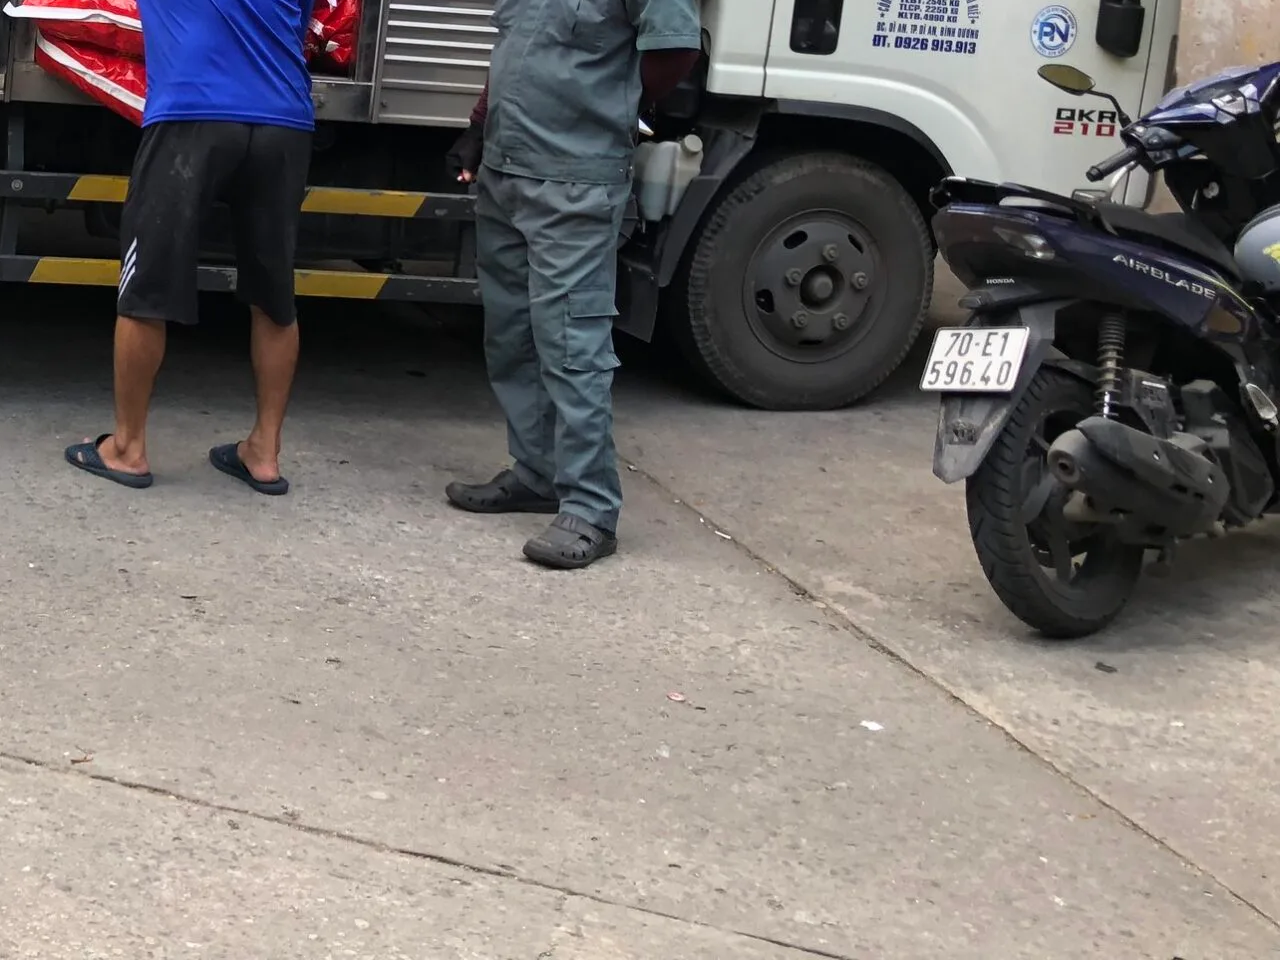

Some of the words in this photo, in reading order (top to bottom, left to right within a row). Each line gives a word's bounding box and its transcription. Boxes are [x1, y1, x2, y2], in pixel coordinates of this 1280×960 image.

[924, 5, 948, 14] 2250
[949, 0, 960, 7] KG
[946, 15, 958, 23] KG
[894, 35, 929, 51] 0926
[931, 39, 977, 55] 913.913
[1056, 107, 1117, 123] QKR
[1053, 121, 1116, 137] 210
[944, 331, 1010, 358] 70-E1
[927, 360, 1013, 387] 596.40
